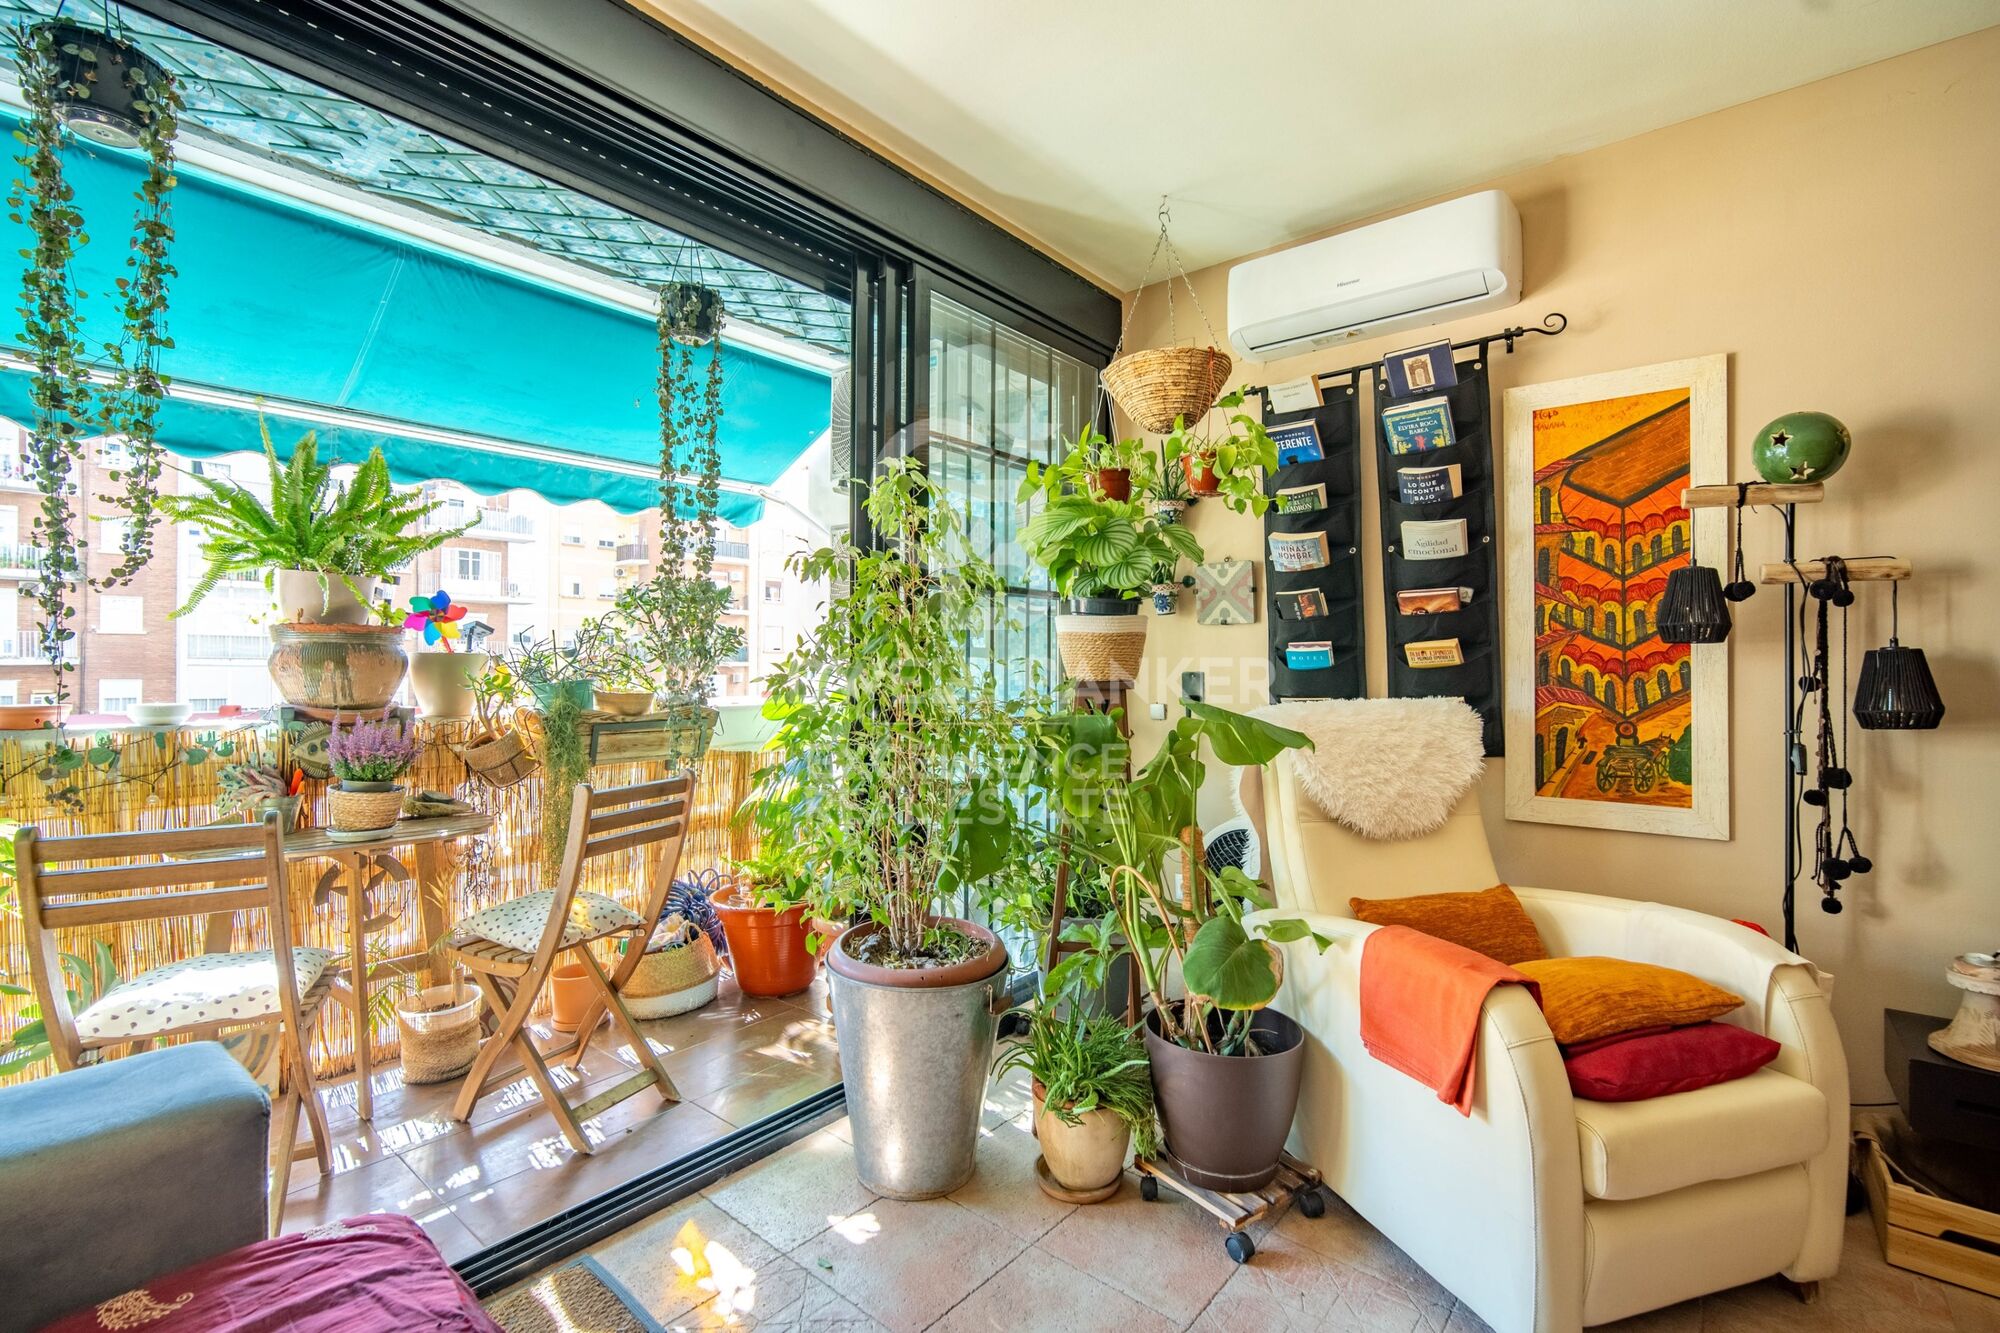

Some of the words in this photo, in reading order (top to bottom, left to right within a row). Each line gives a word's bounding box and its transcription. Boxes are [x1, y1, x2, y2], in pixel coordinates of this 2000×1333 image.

[1397, 423, 1419, 432] ELVIRA
[1419, 420, 1438, 428] ROCA
[1275, 436, 1313, 451] FERENTE
[1403, 483, 1446, 495] ENCONTRÉ
[1419, 480, 1437, 488] QUE
[1280, 544, 1307, 552] NIÑAS
[1414, 538, 1449, 548] Agilidad
[1407, 544, 1458, 555] emocional
[1278, 551, 1313, 560] NOMBRE
